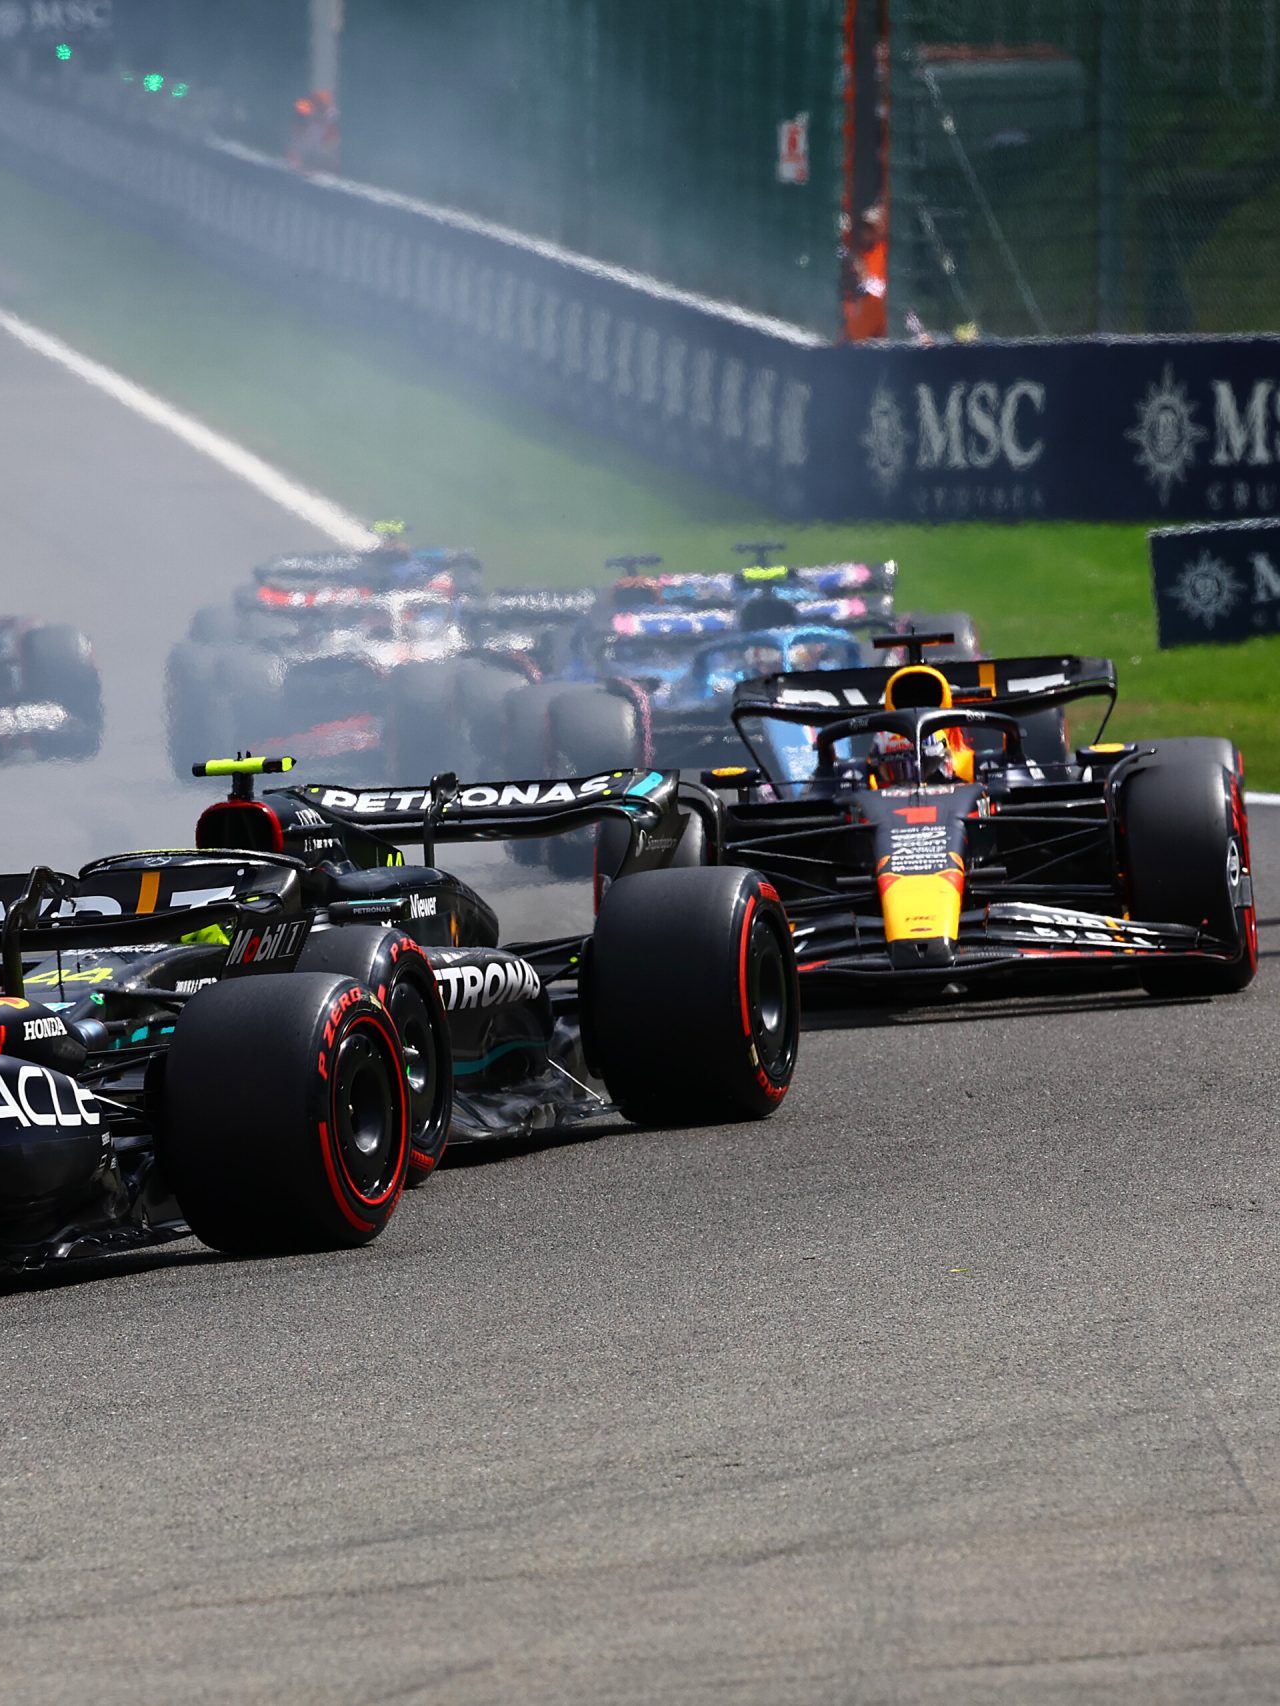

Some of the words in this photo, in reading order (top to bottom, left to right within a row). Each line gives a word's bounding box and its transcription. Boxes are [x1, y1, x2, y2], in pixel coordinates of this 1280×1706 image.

[915, 379, 1045, 470] MSC
[352, 905, 391, 914] PETRONAS
[225, 926, 287, 967] Mobil
[23, 967, 113, 986] 44
[432, 957, 541, 1011] TRONAS
[23, 1016, 68, 1042] HONDA
